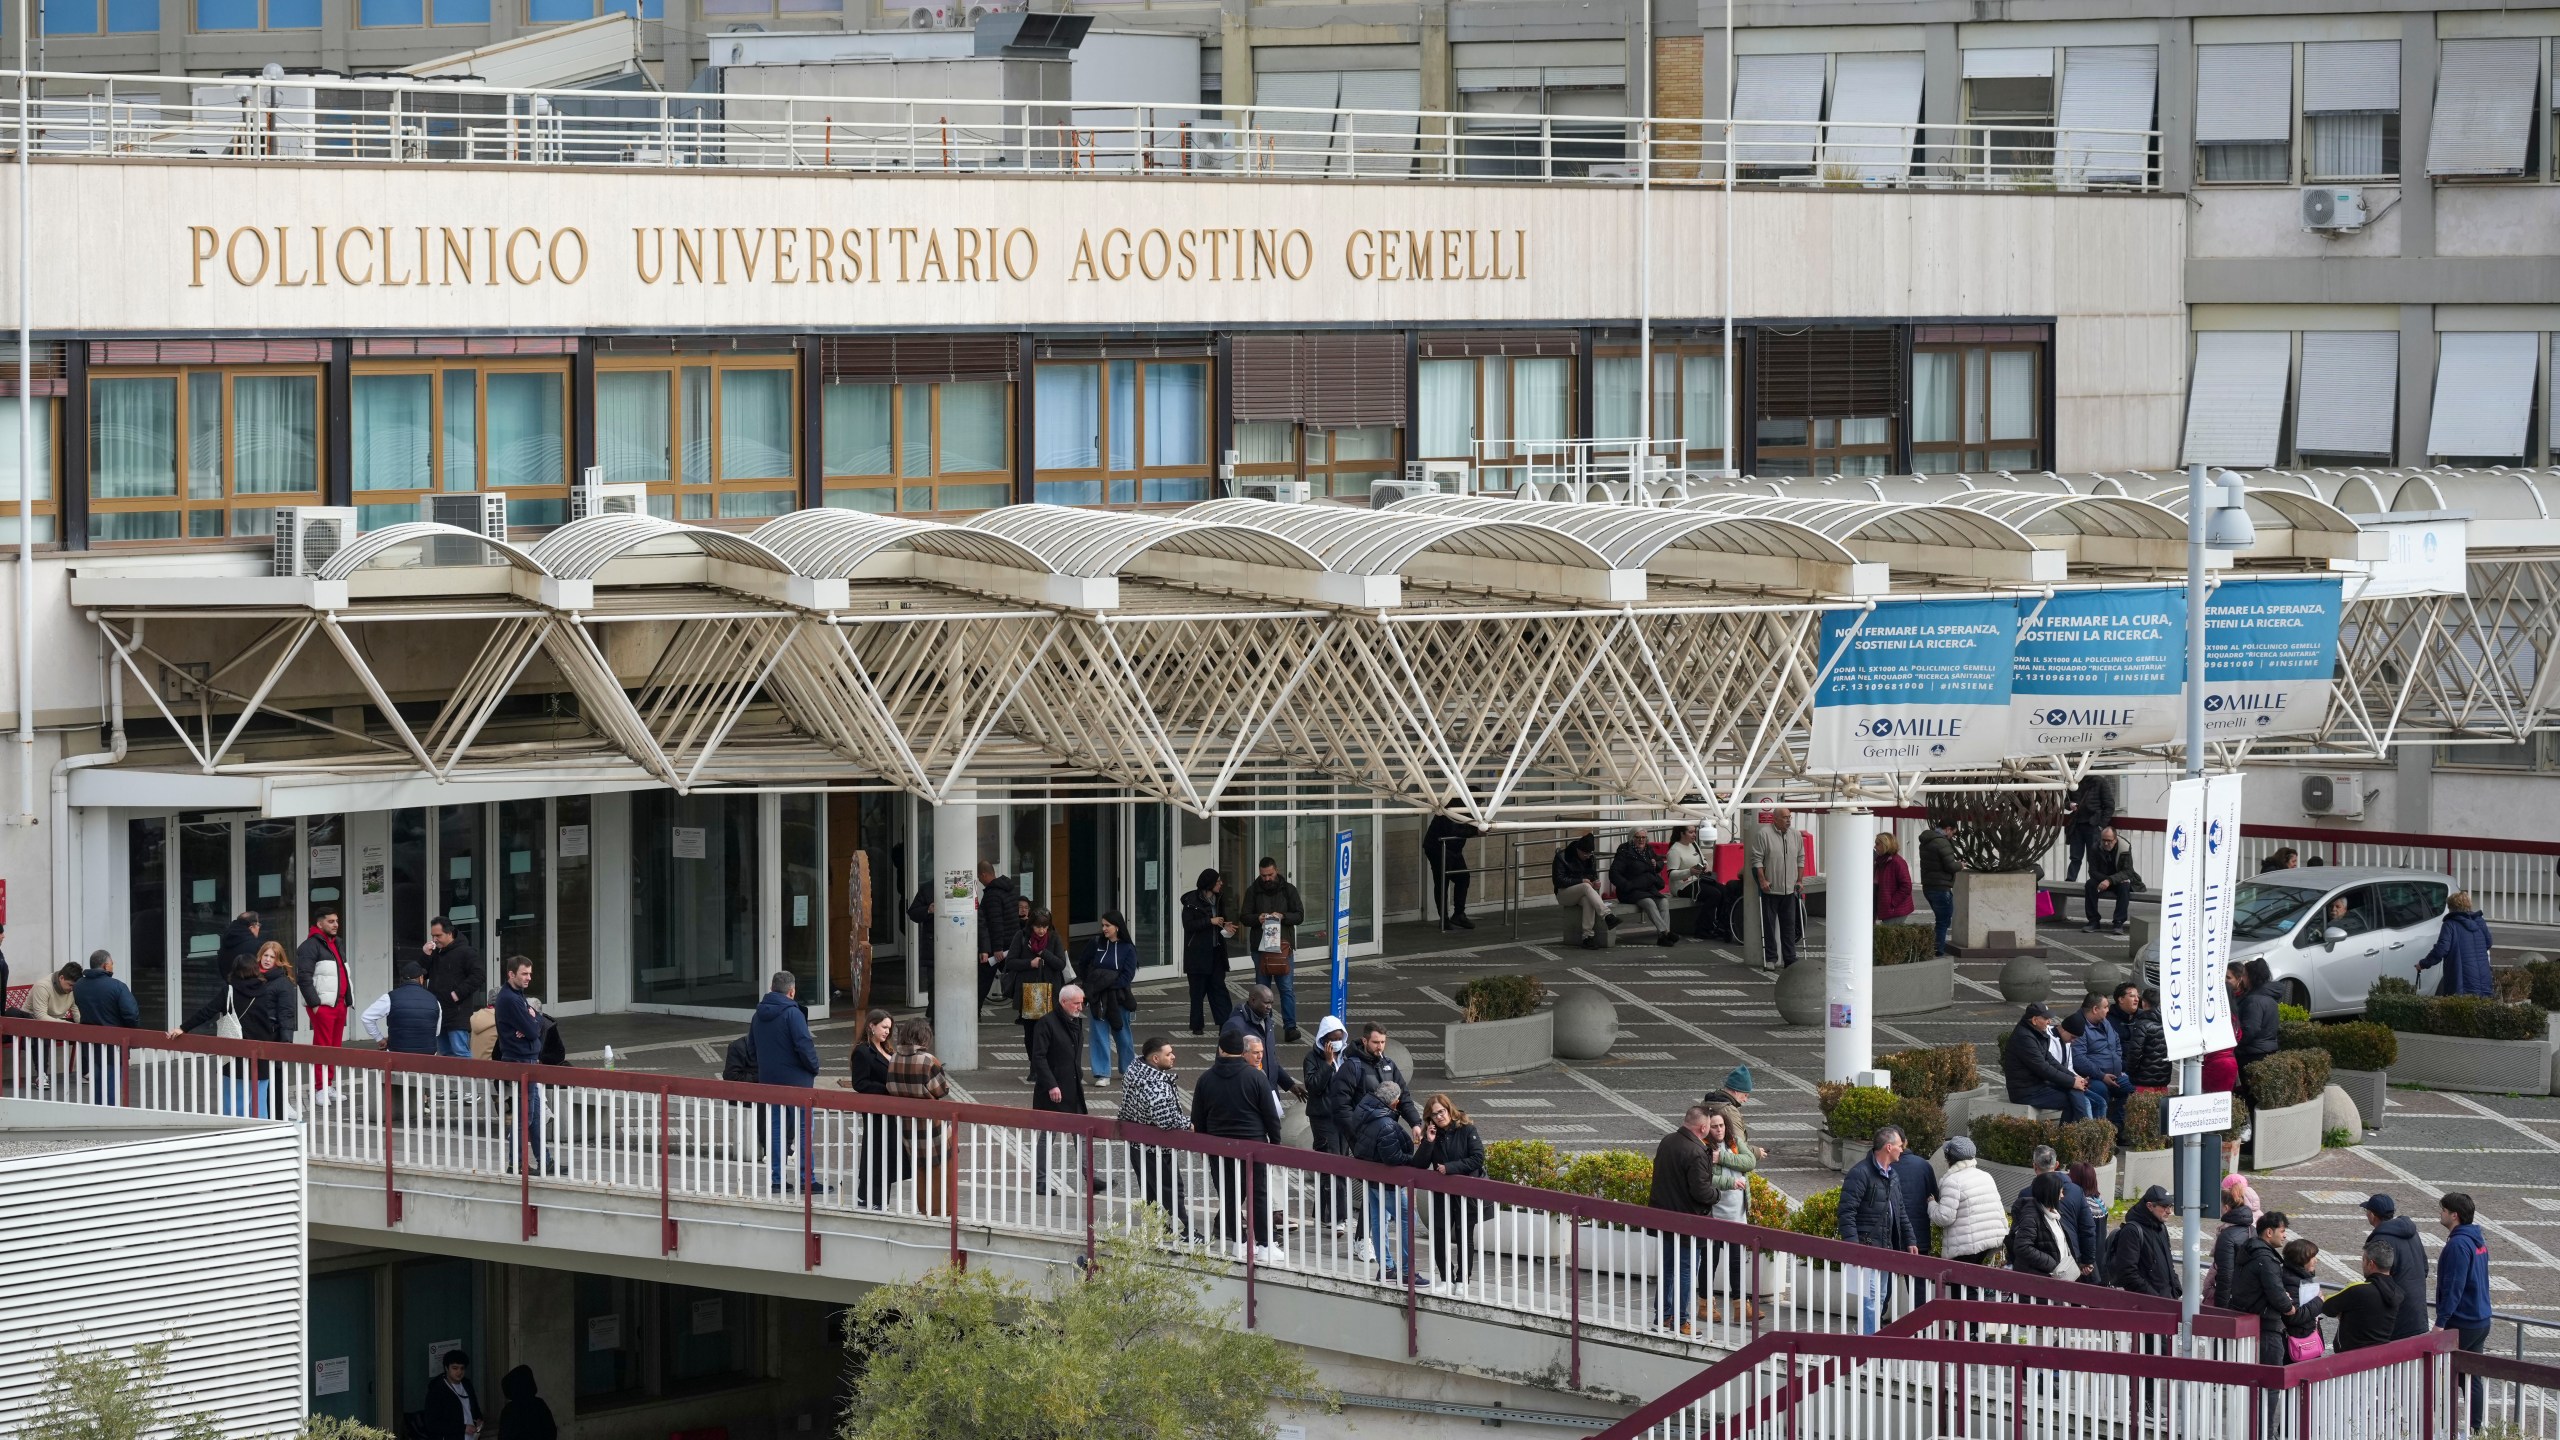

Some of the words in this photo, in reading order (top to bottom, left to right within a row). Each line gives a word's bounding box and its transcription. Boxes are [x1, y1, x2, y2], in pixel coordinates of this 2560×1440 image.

[192, 226, 588, 286] POLICLINICO
[636, 228, 1038, 284] UNIVERSITARIO
[1068, 228, 1312, 281] AGOSTINO
[1346, 230, 1529, 280] GEMELLI
[2205, 606, 2248, 615] ERMARE
[2251, 606, 2265, 615] LA
[2267, 605, 2325, 615] SPERANZA,
[2047, 615, 2108, 627] FERMARE
[2112, 615, 2130, 626] LA
[2132, 614, 2172, 626] CURA,
[2205, 619, 2238, 629] STIENI
[2240, 619, 2254, 628] LA
[2256, 618, 2303, 628] RICERCA.
[1865, 625, 1918, 636] FERMARE
[1921, 625, 1934, 635] LA
[1938, 625, 2000, 635] SPERANZA,
[2084, 630, 2100, 641] LA
[2104, 629, 2162, 641] RICERCA.
[1855, 640, 1906, 650] SOSTIENI
[1909, 640, 1924, 649] LA
[1927, 639, 1977, 648] RICERCA.
[2205, 717, 2246, 729] emelli
[2038, 732, 2093, 744] Gemelli
[1863, 744, 1919, 757] Gemelli
[2204, 885, 2218, 1023] Gemelli
[2167, 891, 2183, 1031] Gemelli
[2180, 1109, 2212, 1117] Coordinamento
[2174, 1116, 2229, 1128] Preospedalizzazione
